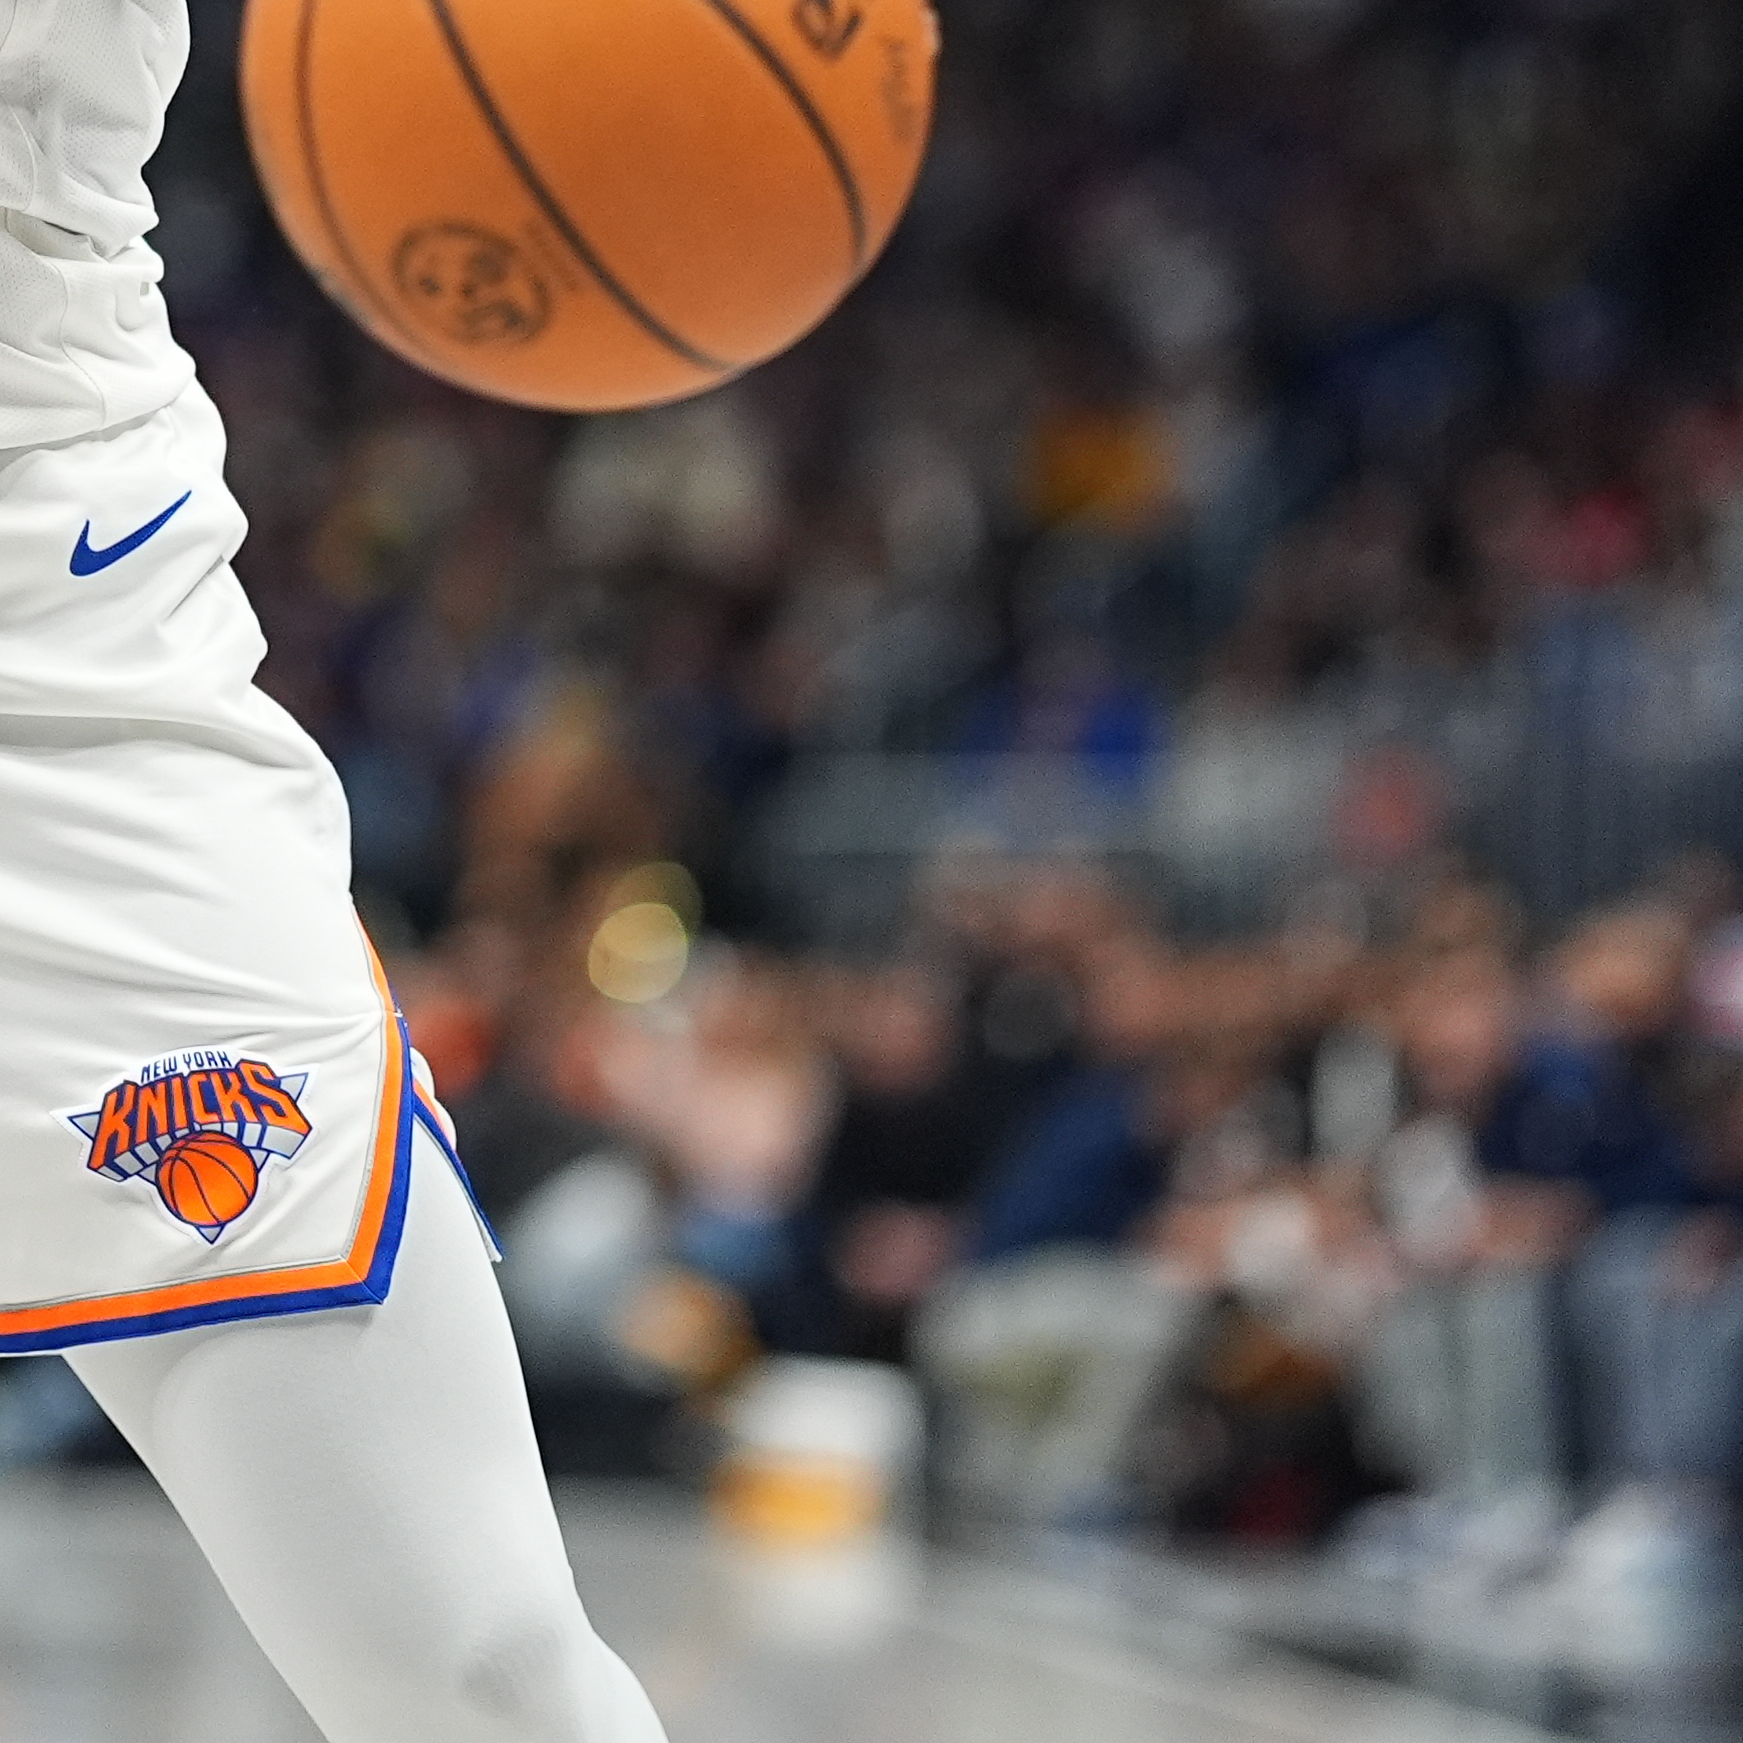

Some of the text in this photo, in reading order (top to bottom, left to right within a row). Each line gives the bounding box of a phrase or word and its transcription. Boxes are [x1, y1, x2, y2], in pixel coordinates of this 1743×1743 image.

[140, 1050, 233, 1084] NEW YORK
[86, 1058, 313, 1179] KNICKS
